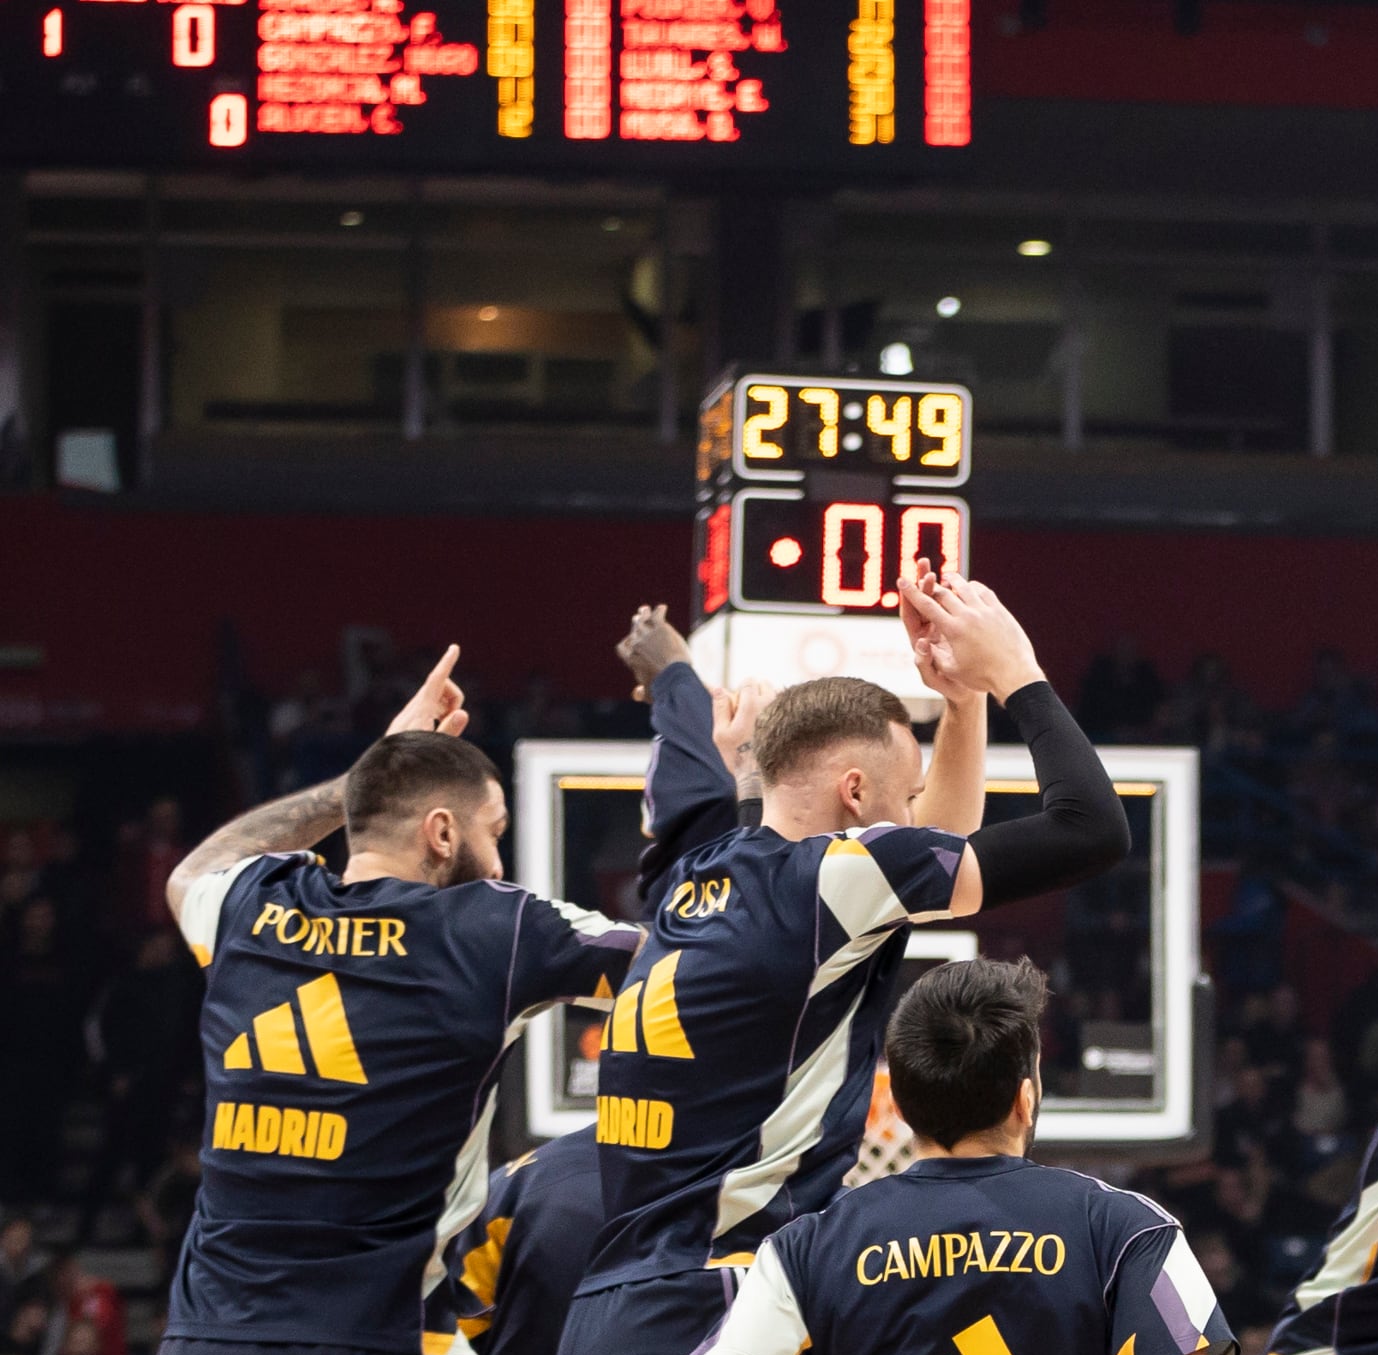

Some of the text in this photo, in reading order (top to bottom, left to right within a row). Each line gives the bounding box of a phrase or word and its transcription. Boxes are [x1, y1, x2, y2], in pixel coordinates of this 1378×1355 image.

[172, 4, 215, 67] 0
[209, 93, 248, 147] 0
[742, 384, 963, 467] 27:49
[212, 1102, 348, 1161] MADRID
[596, 1095, 675, 1150] ADRID
[856, 1230, 1066, 1287] CAMPAZZO
